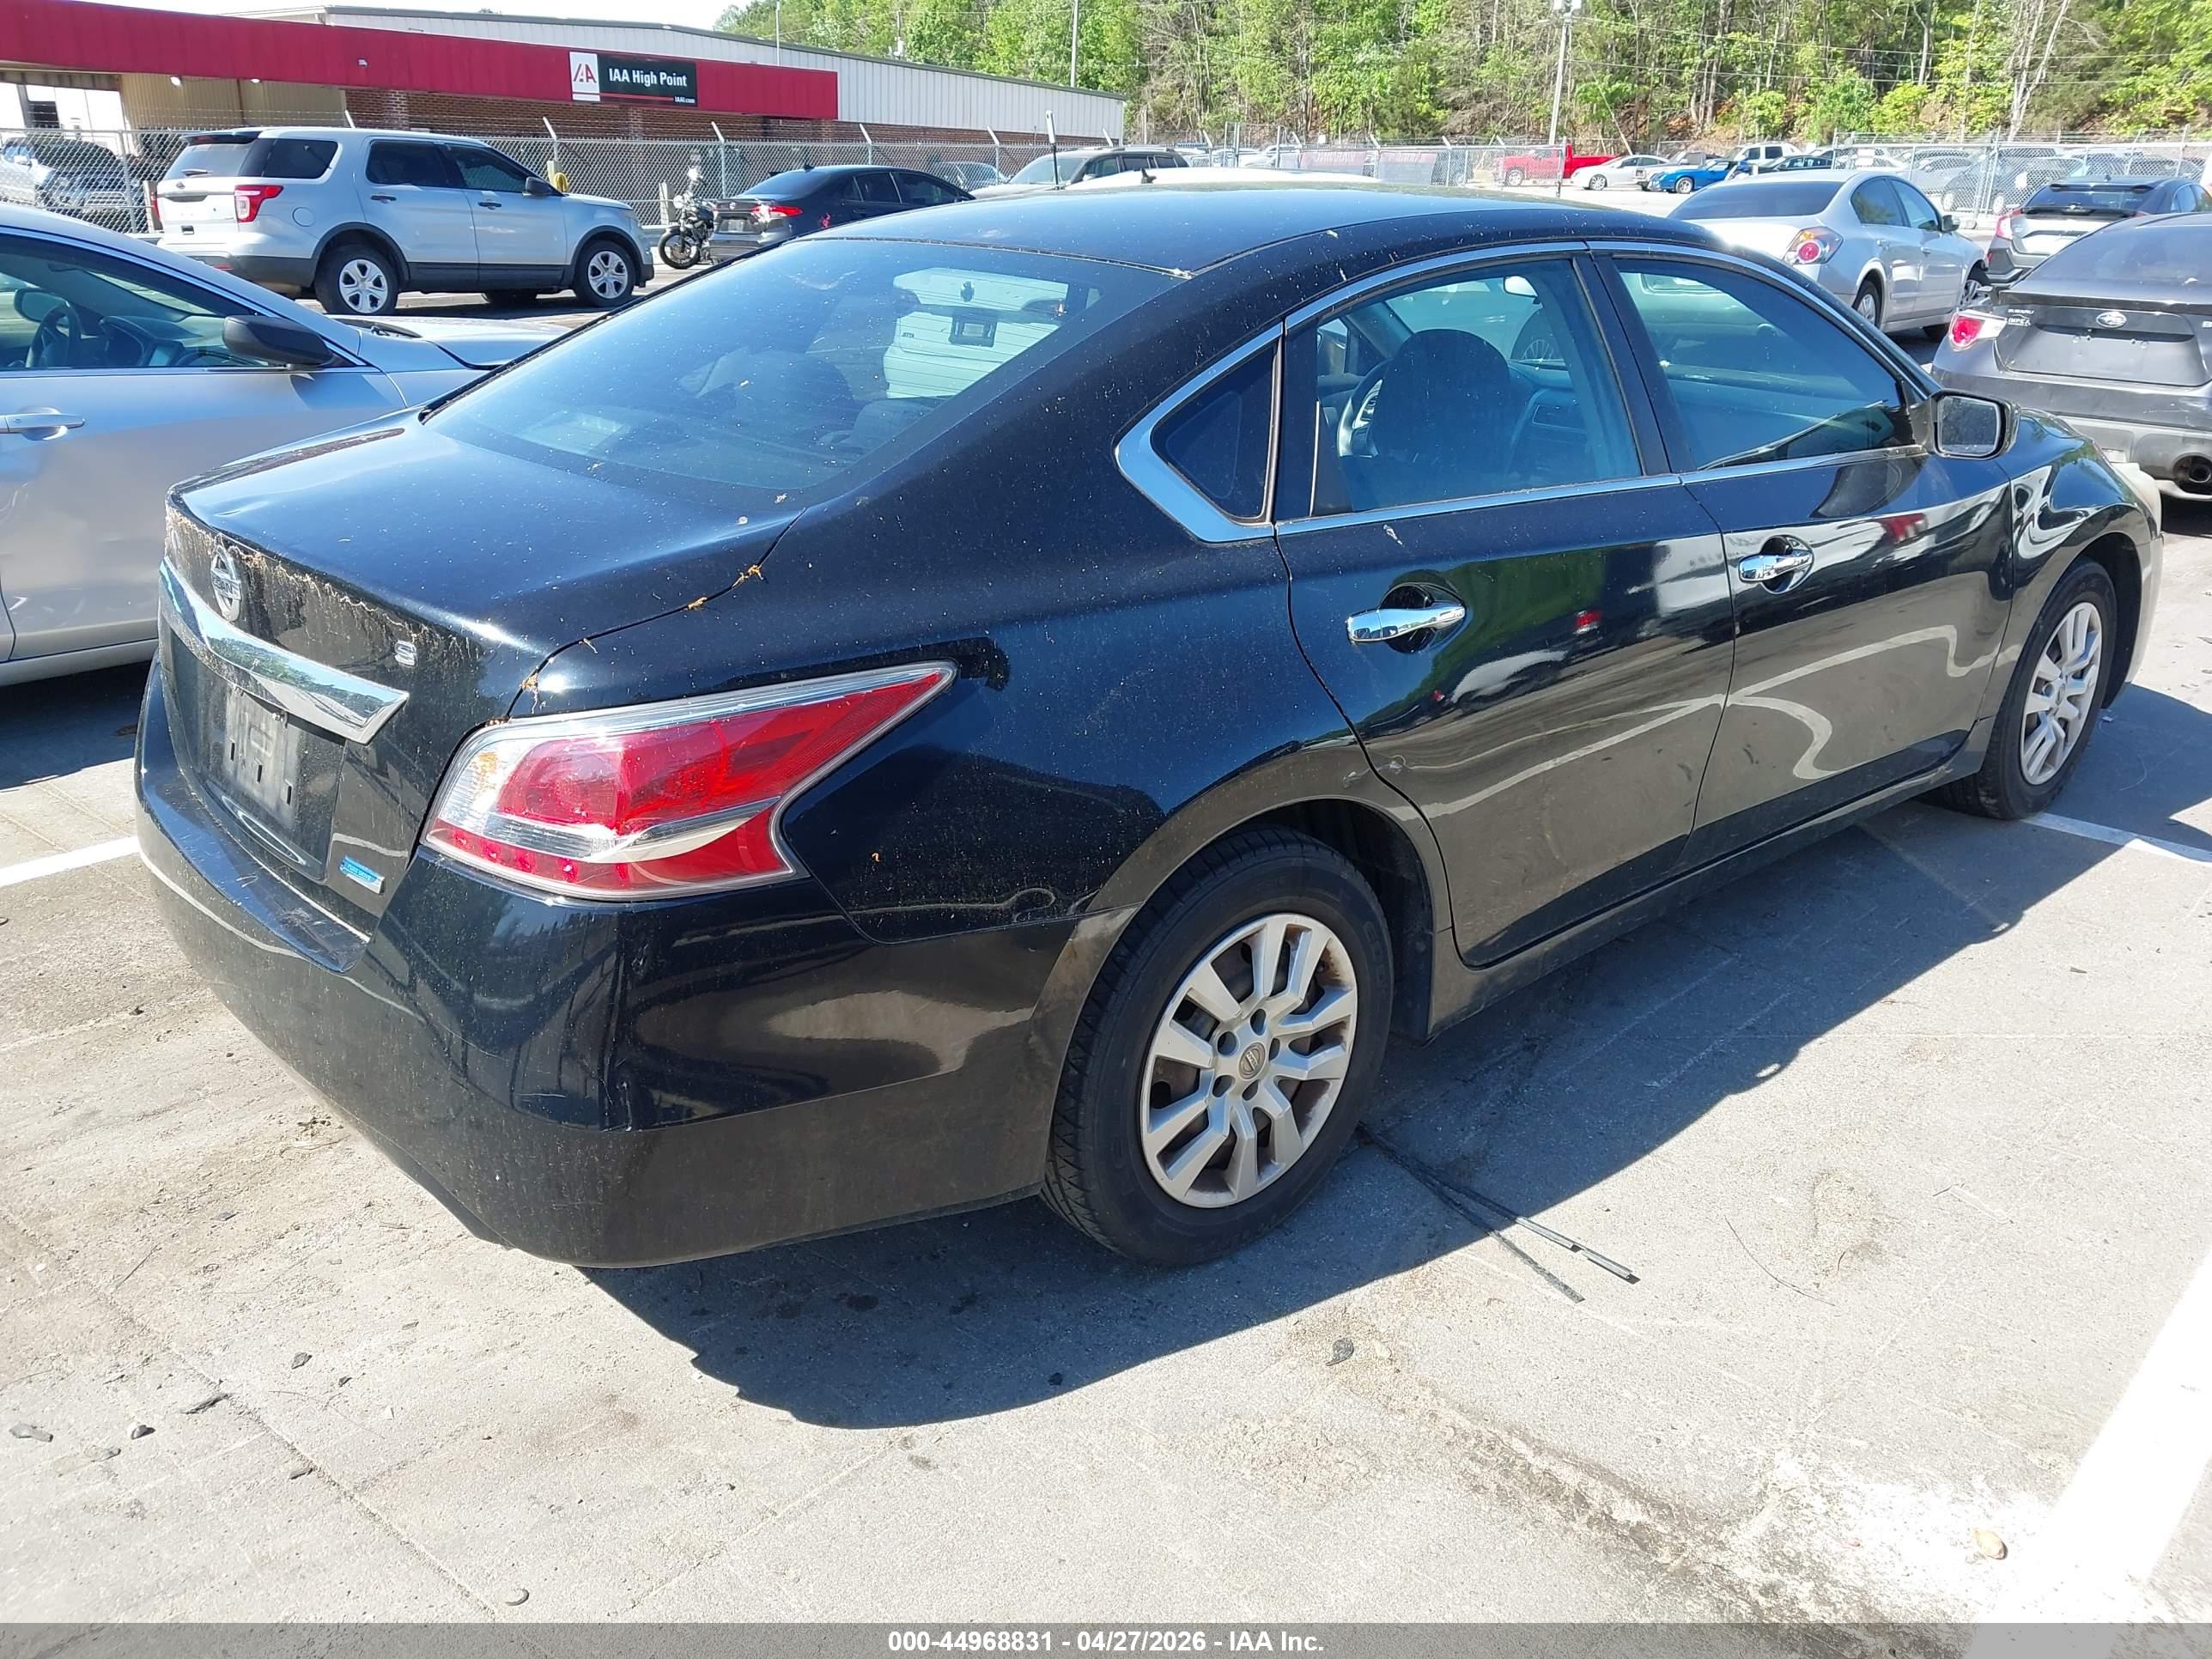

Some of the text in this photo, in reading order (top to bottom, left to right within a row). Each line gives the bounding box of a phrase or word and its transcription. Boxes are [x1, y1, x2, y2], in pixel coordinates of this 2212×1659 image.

[609, 68, 688, 87] IAA High Point
[394, 640, 418, 666] S
